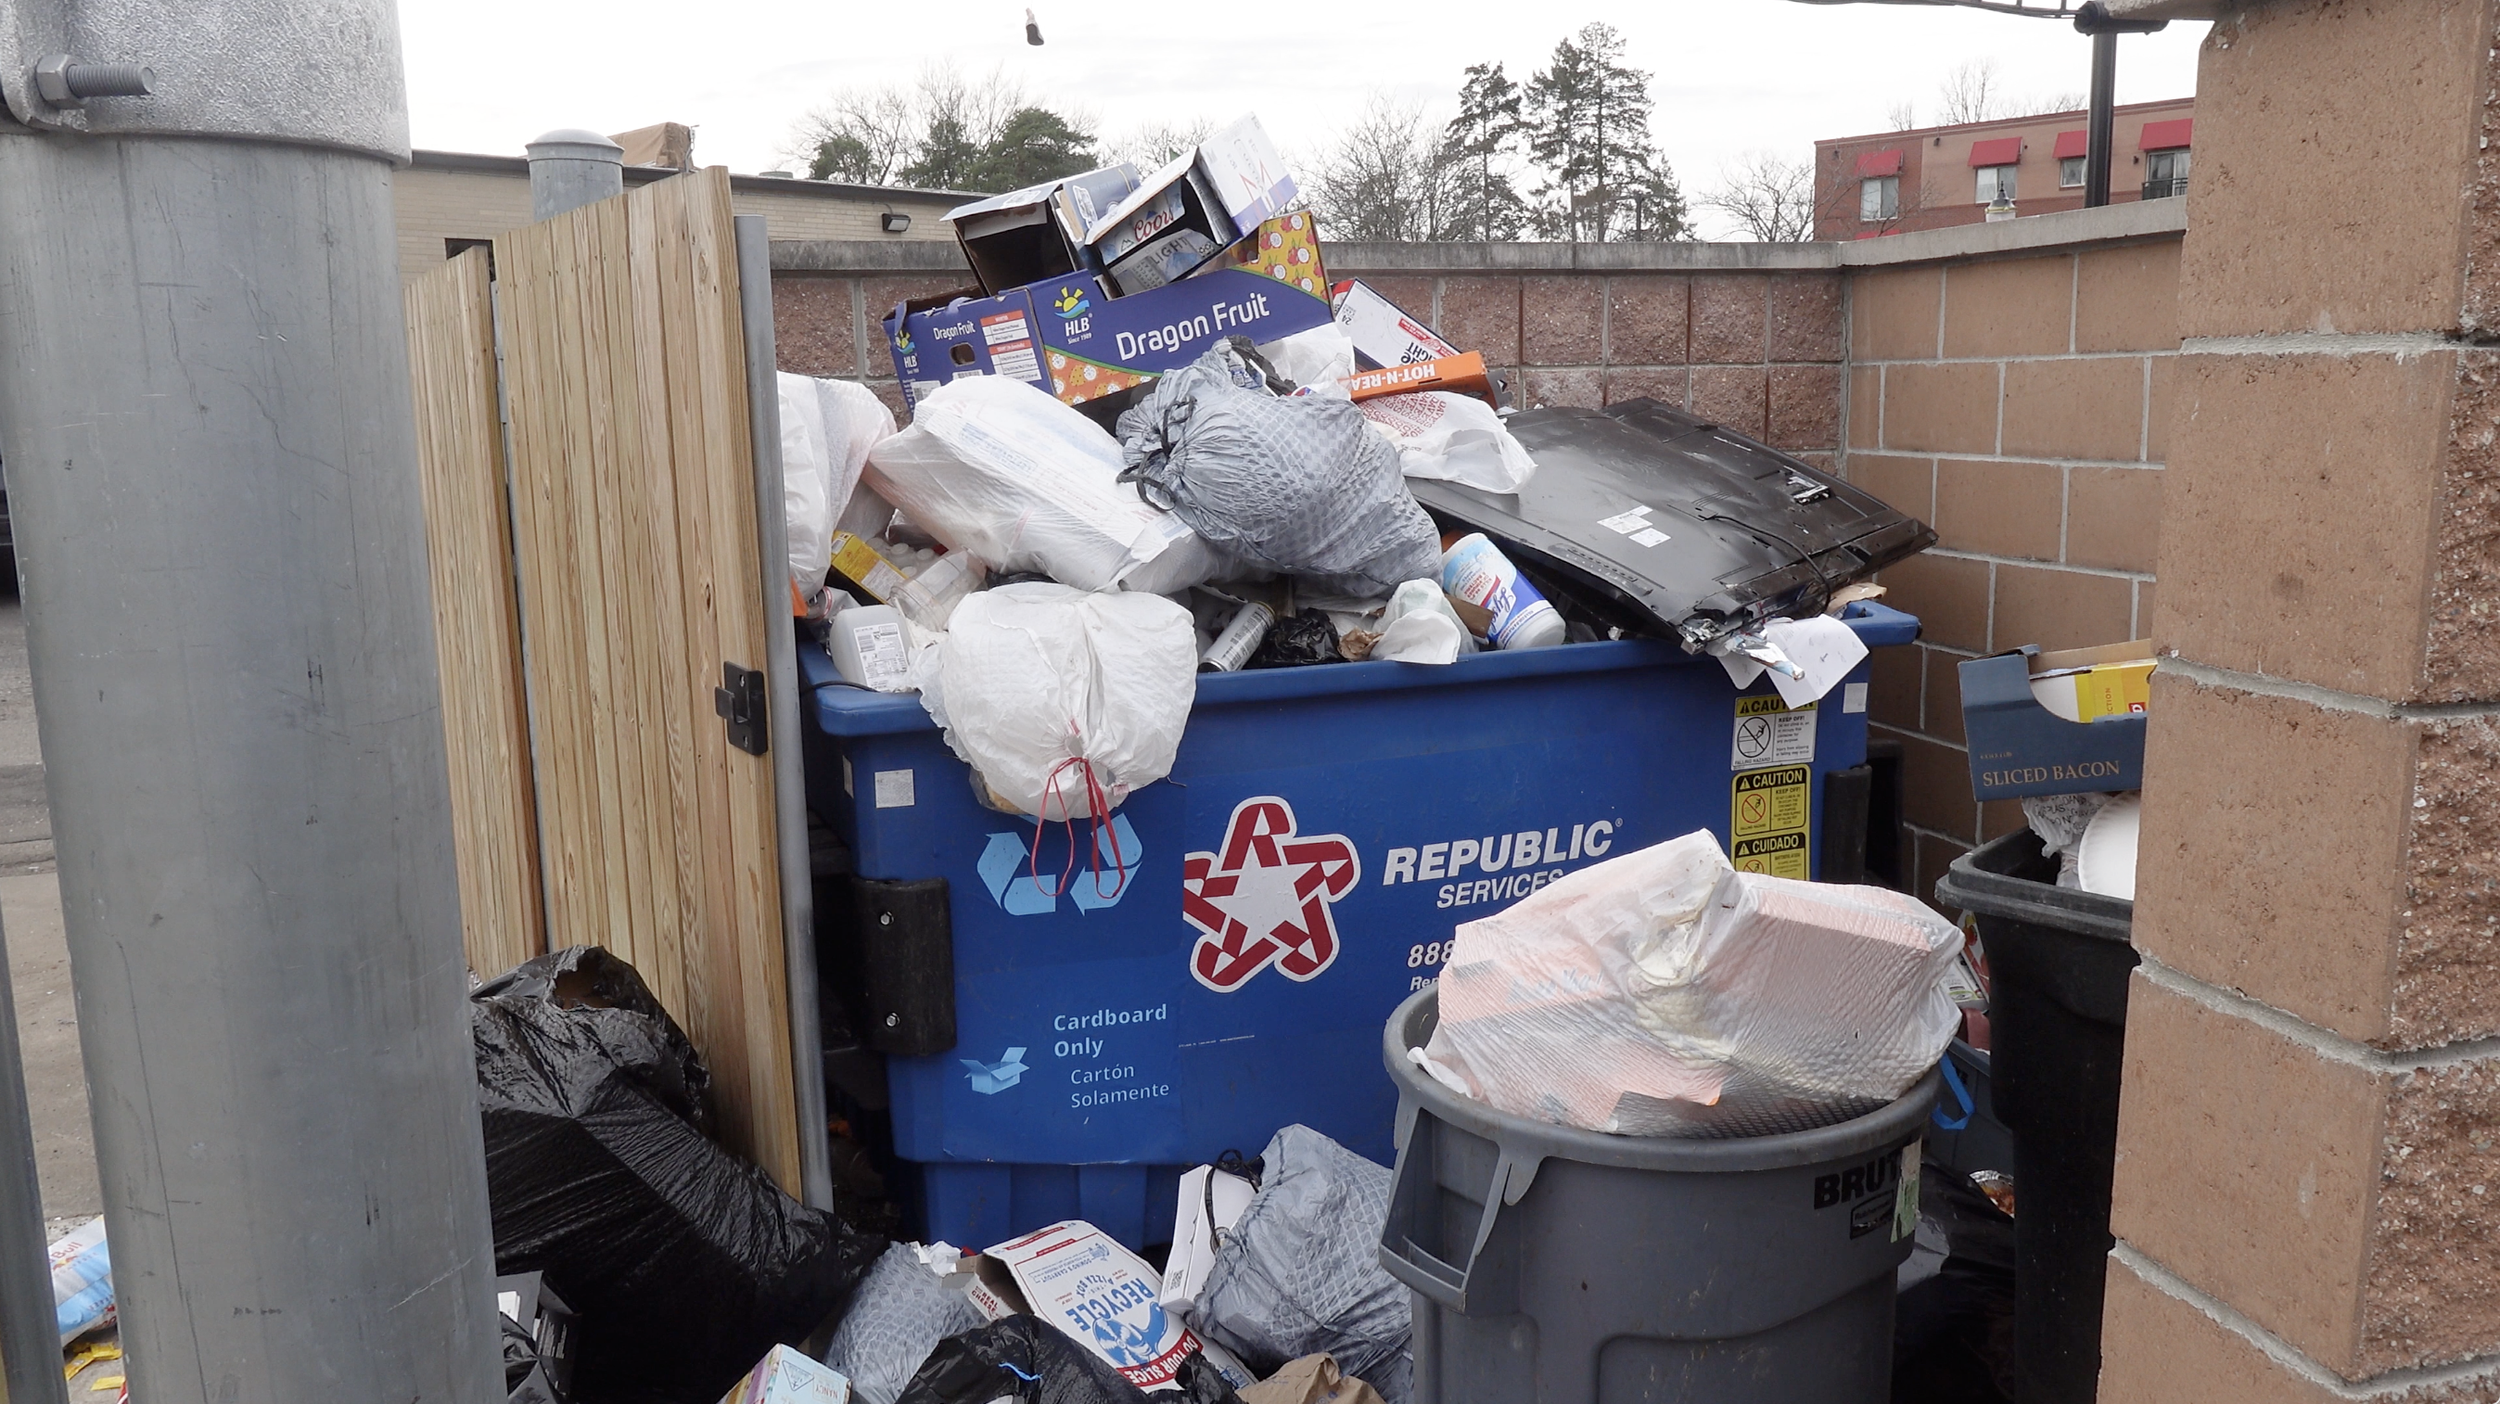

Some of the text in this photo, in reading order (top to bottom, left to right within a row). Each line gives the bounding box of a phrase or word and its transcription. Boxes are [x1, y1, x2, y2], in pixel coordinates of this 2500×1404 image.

[1134, 205, 1174, 242] Coors
[1150, 236, 1188, 265] LIGHT
[933, 325, 958, 340] Dragon
[957, 320, 976, 336] Fruit
[1065, 316, 1090, 337] HLB
[1116, 292, 1270, 361] Dragon Fruit
[904, 355, 918, 369] HLB
[1404, 341, 1437, 365] IGHT
[1489, 587, 1513, 633] Lysol
[1752, 769, 1803, 788] CAUTION
[1982, 760, 2120, 787] SLICED BACON
[1382, 820, 1614, 886] REPUBLIC
[1752, 835, 1799, 853] CUIDADO
[1054, 1004, 1167, 1031] Cardboard
[1054, 1037, 1104, 1059] Only
[1070, 1063, 1135, 1085] Cartón
[1071, 1083, 1170, 1108] Solamente
[1814, 1151, 1898, 1210] BRUT
[971, 1289, 997, 1314] CHEESE
[981, 1290, 998, 1308] REAL
[1075, 1280, 1088, 1299] BOX
[1065, 1277, 1155, 1332] RECYCLE
[1124, 1362, 1165, 1385] SLICE
